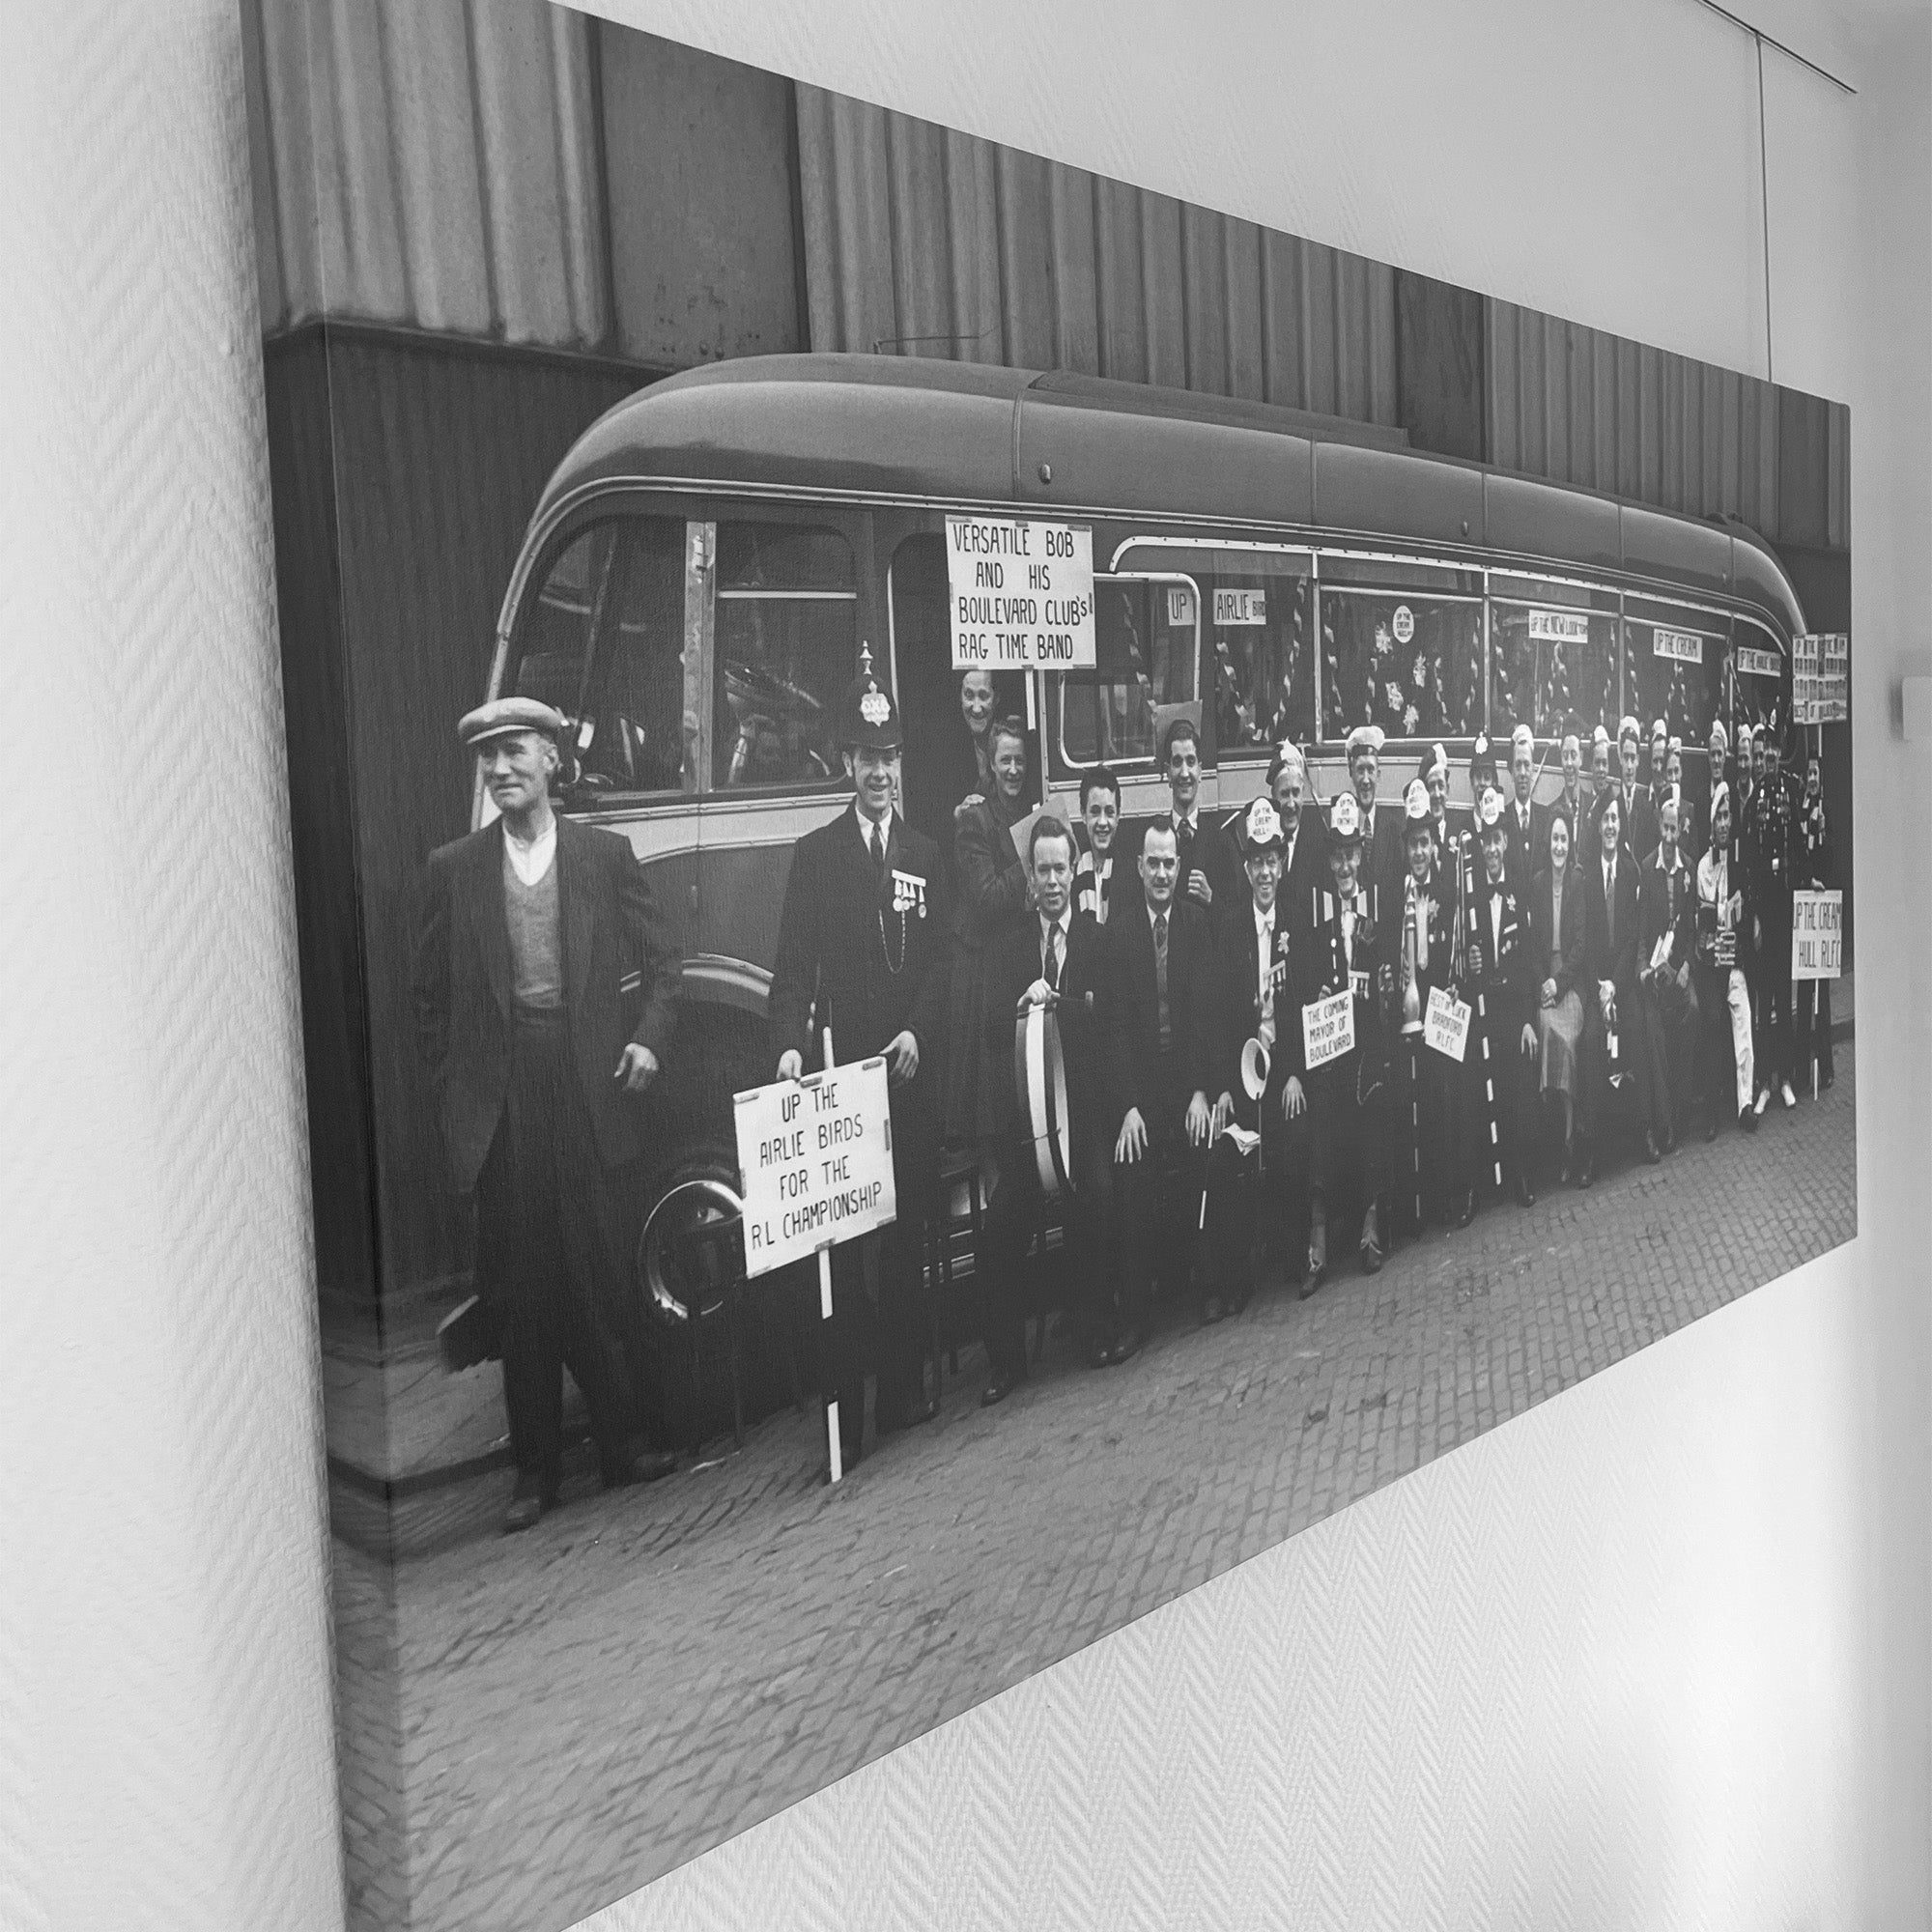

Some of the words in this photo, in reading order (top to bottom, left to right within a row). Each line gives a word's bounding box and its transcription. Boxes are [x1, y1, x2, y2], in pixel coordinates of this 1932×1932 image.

[953, 524, 1031, 555] VERSATILE
[1046, 530, 1074, 557] BOB
[976, 561, 1004, 588] AND
[1029, 564, 1050, 590] HIS
[958, 596, 1037, 625] BOULEVARD
[1172, 593, 1186, 619] UP
[1217, 594, 1249, 620] AIRLIE
[958, 633, 988, 659] RAG
[995, 634, 1029, 659] TIME
[1037, 634, 1073, 660] BAND
[1804, 901, 1816, 930] THE
[1799, 940, 1817, 968] HULL
[1820, 939, 1840, 968] RLFC
[1308, 1008, 1321, 1024] THE
[1323, 996, 1349, 1019] COMING
[1310, 1021, 1334, 1043] MAYOR
[1339, 1015, 1347, 1032] OF
[1310, 1033, 1351, 1063] BOULEVARD
[781, 1094, 801, 1122] UP
[811, 1083, 838, 1112] THE
[760, 1130, 805, 1168] AIRLIE
[818, 1113, 863, 1150] BIRDS
[780, 1169, 809, 1200] FOR
[821, 1155, 851, 1185] THE
[782, 1180, 882, 1238] CHAMPIONSHIP
